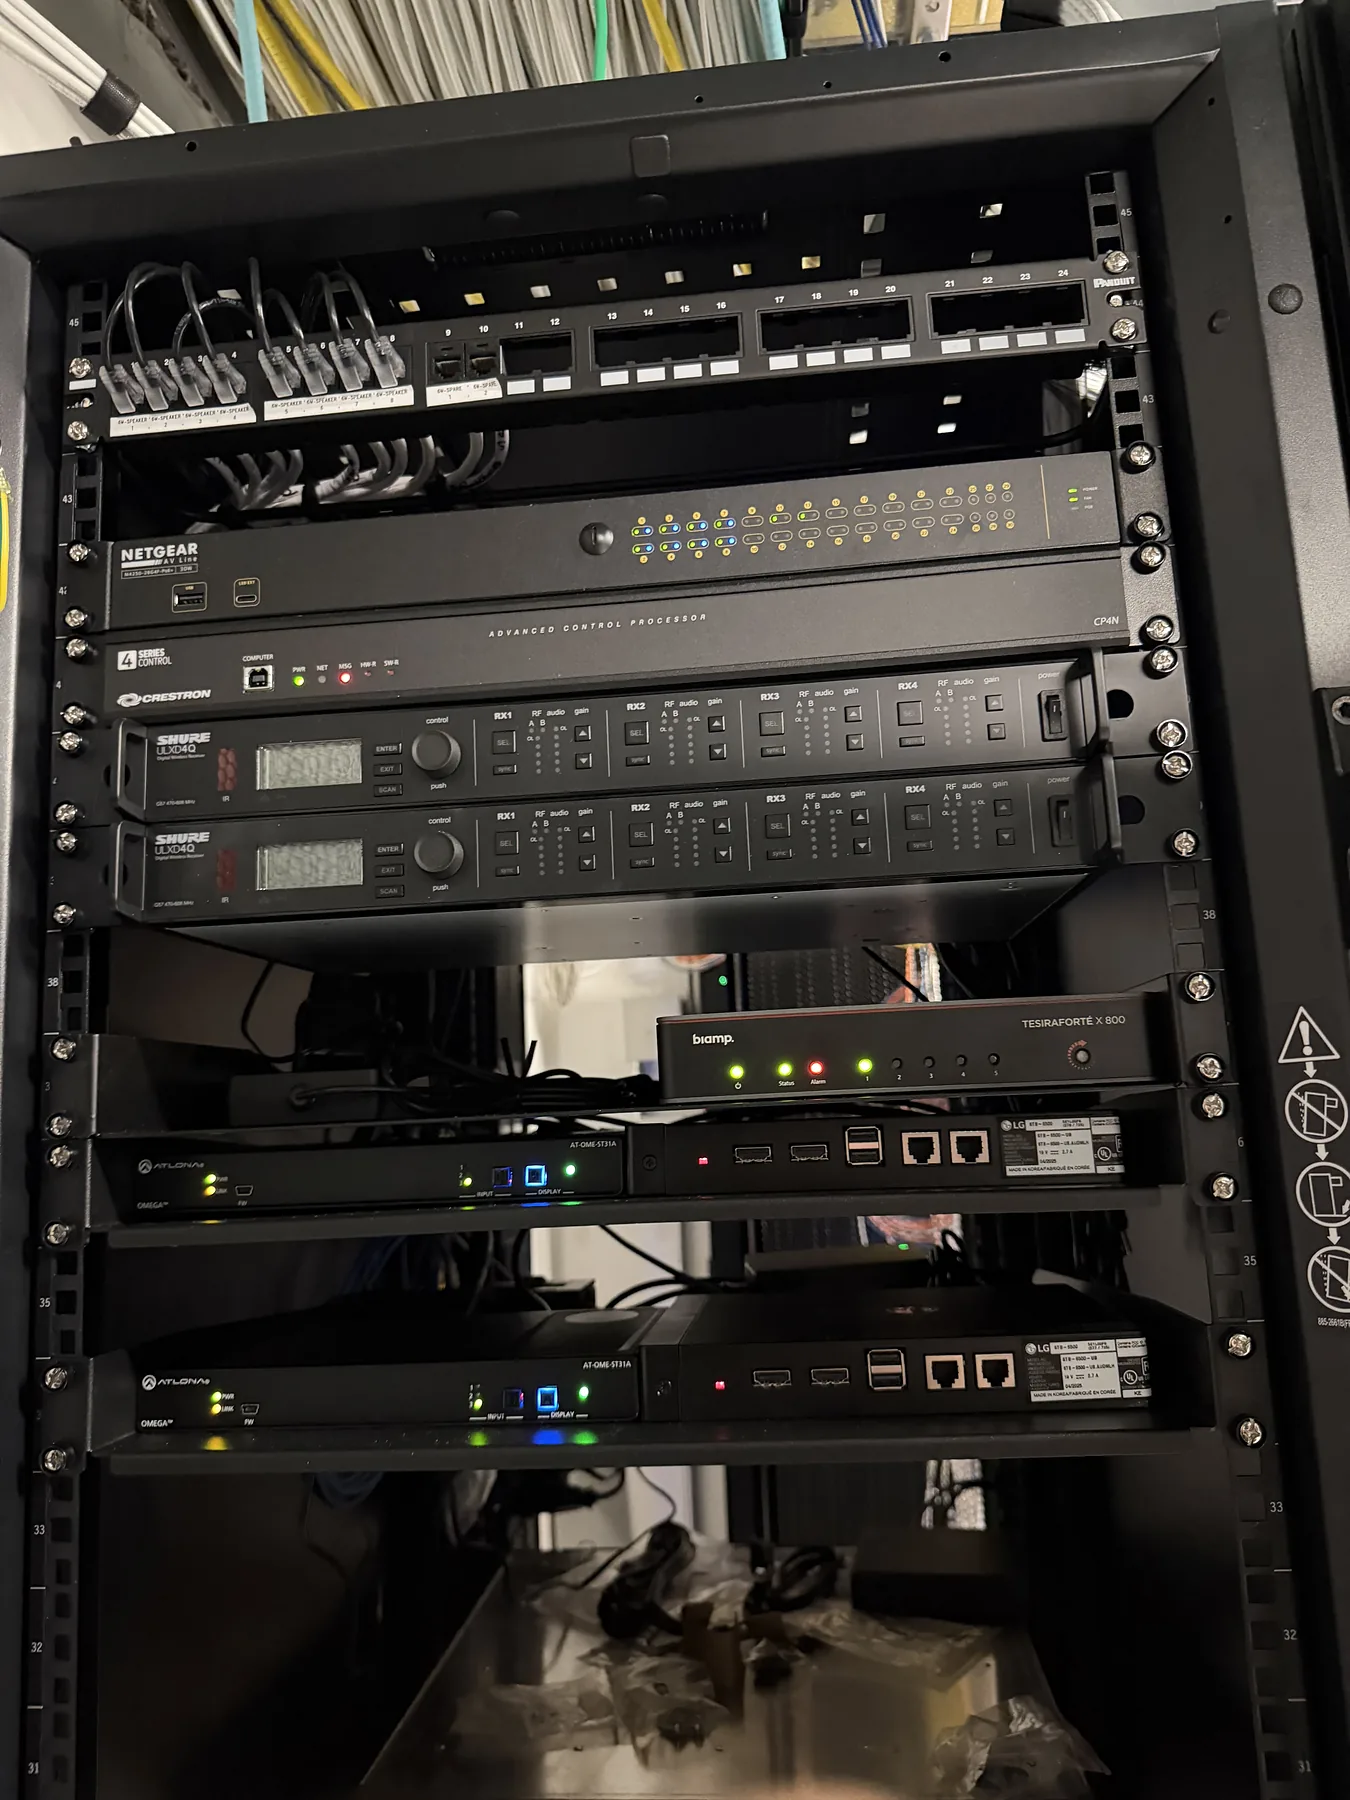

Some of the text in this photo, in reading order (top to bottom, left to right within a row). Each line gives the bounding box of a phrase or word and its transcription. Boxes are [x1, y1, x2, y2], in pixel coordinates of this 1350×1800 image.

[1121, 208, 1132, 216] 45
[1093, 276, 1136, 288] PANDUIT
[848, 288, 859, 297] 19
[607, 301, 726, 320] 13 14 15 16
[69, 319, 79, 327] 45
[1142, 395, 1154, 403] 43
[62, 494, 73, 504] 43
[121, 542, 198, 561] NETGEAR
[1094, 616, 1119, 626] CP4N
[489, 614, 707, 638] ADVANCED CONTROL PROCESSOR
[138, 648, 165, 659] SERIES
[242, 654, 274, 662] COMPUTER
[138, 656, 172, 667] CONTROL
[1038, 671, 1060, 680] power
[954, 678, 974, 686] audio
[984, 676, 999, 685] gain
[898, 682, 918, 691] RX4
[142, 689, 211, 703] CRESTRON
[814, 689, 834, 697] audio
[844, 687, 859, 696] gain
[761, 693, 780, 701] RX3
[679, 699, 698, 707] audio
[707, 697, 723, 706] gain
[547, 708, 565, 716] audio
[574, 707, 589, 716] gain
[627, 703, 645, 711] RX2
[494, 712, 512, 720] RX1
[426, 717, 449, 725] control
[157, 732, 211, 745] SHURE
[156, 744, 196, 755] ULXD4Q
[962, 781, 982, 790] audio
[992, 780, 1008, 788] gain
[1047, 776, 1070, 785] power
[378, 786, 397, 794] SCAN
[430, 783, 447, 791] push
[906, 785, 926, 793] RX4
[850, 789, 866, 798] gain
[713, 799, 728, 807] gain
[766, 795, 786, 803] RX3
[578, 808, 593, 816] gain
[631, 804, 650, 812] RX2
[497, 812, 515, 820] RX1
[428, 817, 451, 825] control
[155, 832, 210, 845] SHURE
[155, 844, 195, 854] ULXD4Q
[380, 887, 398, 895] SCAN
[432, 884, 449, 892] push
[1203, 910, 1216, 919] 38
[47, 978, 59, 986] 38
[1022, 1016, 1093, 1028] TESIRAFORTÉ
[1105, 1016, 1126, 1024] 800
[692, 1033, 734, 1045] biamp.
[1243, 1255, 1256, 1266] 35
[40, 1298, 51, 1308] 35
[1038, 1344, 1049, 1352] LG
[583, 1360, 632, 1369] AT-OME-ST31A
[1270, 1501, 1283, 1513] 33
[34, 1525, 46, 1535] 33
[1283, 1629, 1297, 1640] 32
[31, 1642, 43, 1653] 32
[28, 1762, 39, 1774] 31
[1298, 1761, 1311, 1772] 31
